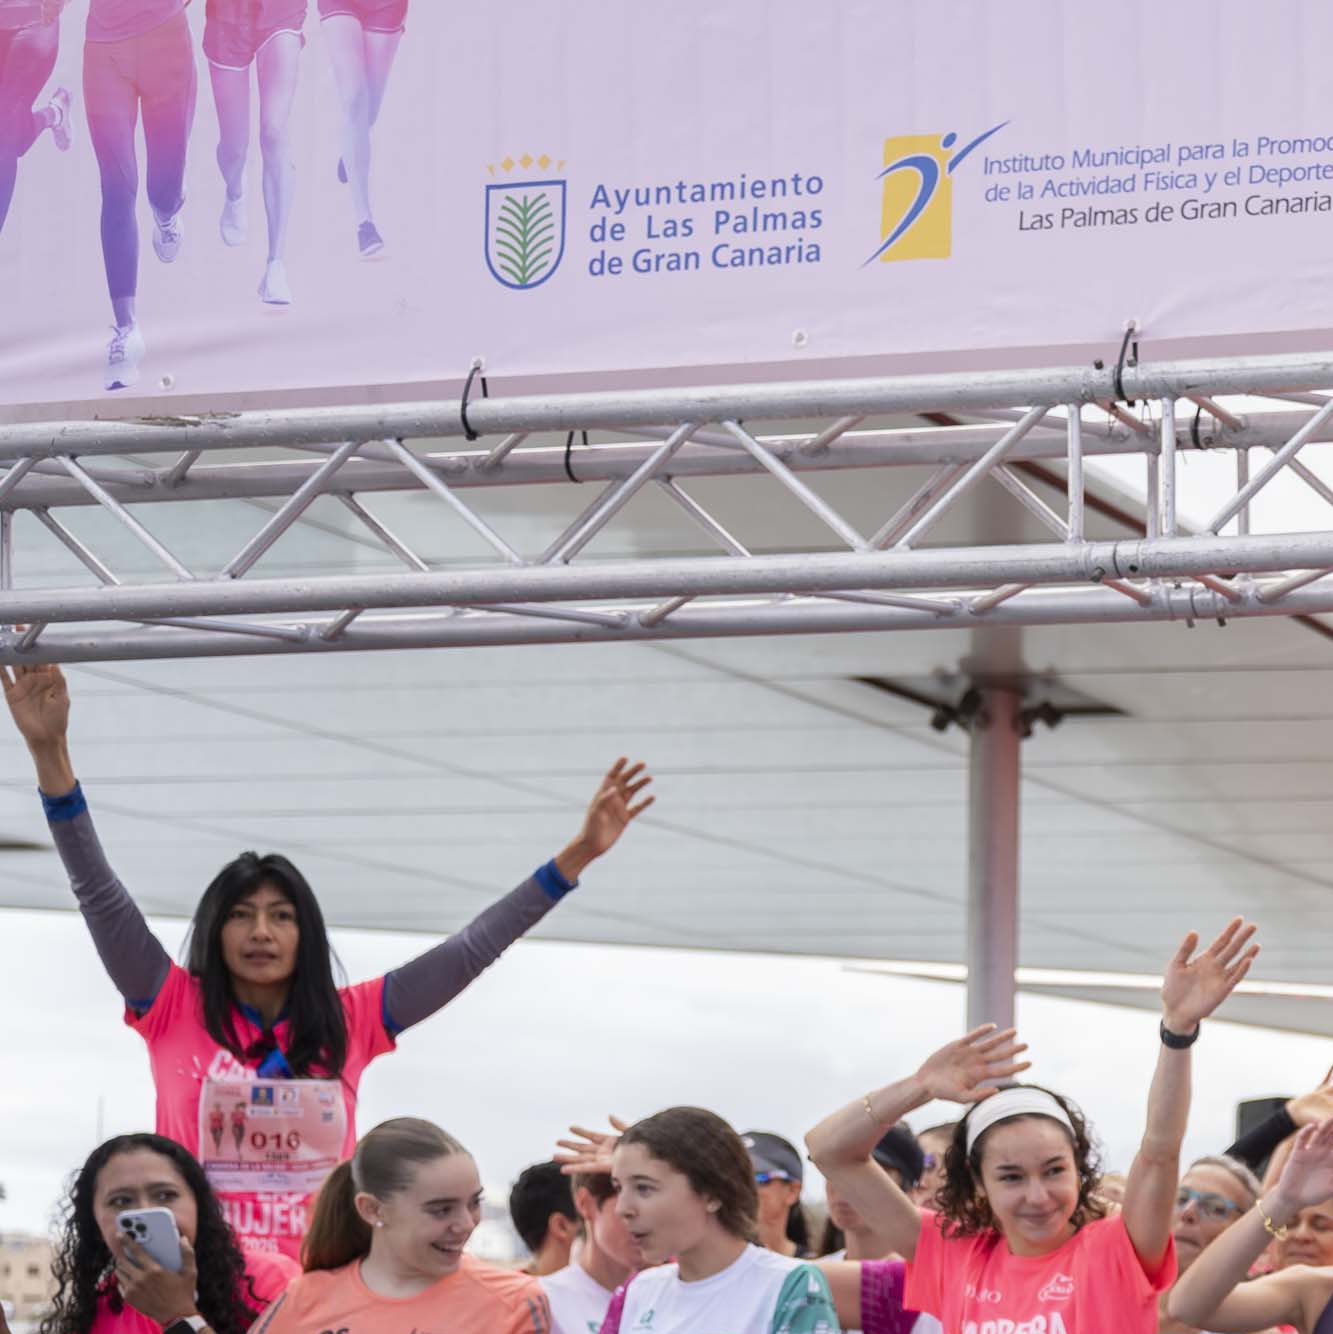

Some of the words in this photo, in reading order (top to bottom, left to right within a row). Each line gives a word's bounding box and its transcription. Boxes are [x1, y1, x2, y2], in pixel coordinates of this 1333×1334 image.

[984, 152, 1066, 175] Instituto
[1072, 143, 1171, 172] Municipal
[1177, 141, 1226, 168] para
[1232, 138, 1250, 158] la
[590, 171, 825, 215] Ayuntamiento
[985, 181, 1012, 202] de
[1017, 180, 1035, 201] la
[1040, 172, 1136, 200] Actividad
[1143, 168, 1199, 193] Física
[1202, 173, 1217, 194] y
[1223, 164, 1242, 187] el
[589, 218, 626, 243] de
[646, 213, 695, 240] Las
[714, 207, 824, 236] Palmas
[1018, 209, 1055, 231] Las
[1061, 203, 1139, 230] Palmas
[1144, 201, 1175, 224] de
[1181, 197, 1239, 221] Gran
[1244, 192, 1333, 216] Canaria
[588, 250, 623, 277] de
[632, 246, 701, 275] Gran
[711, 238, 822, 271] Canaria
